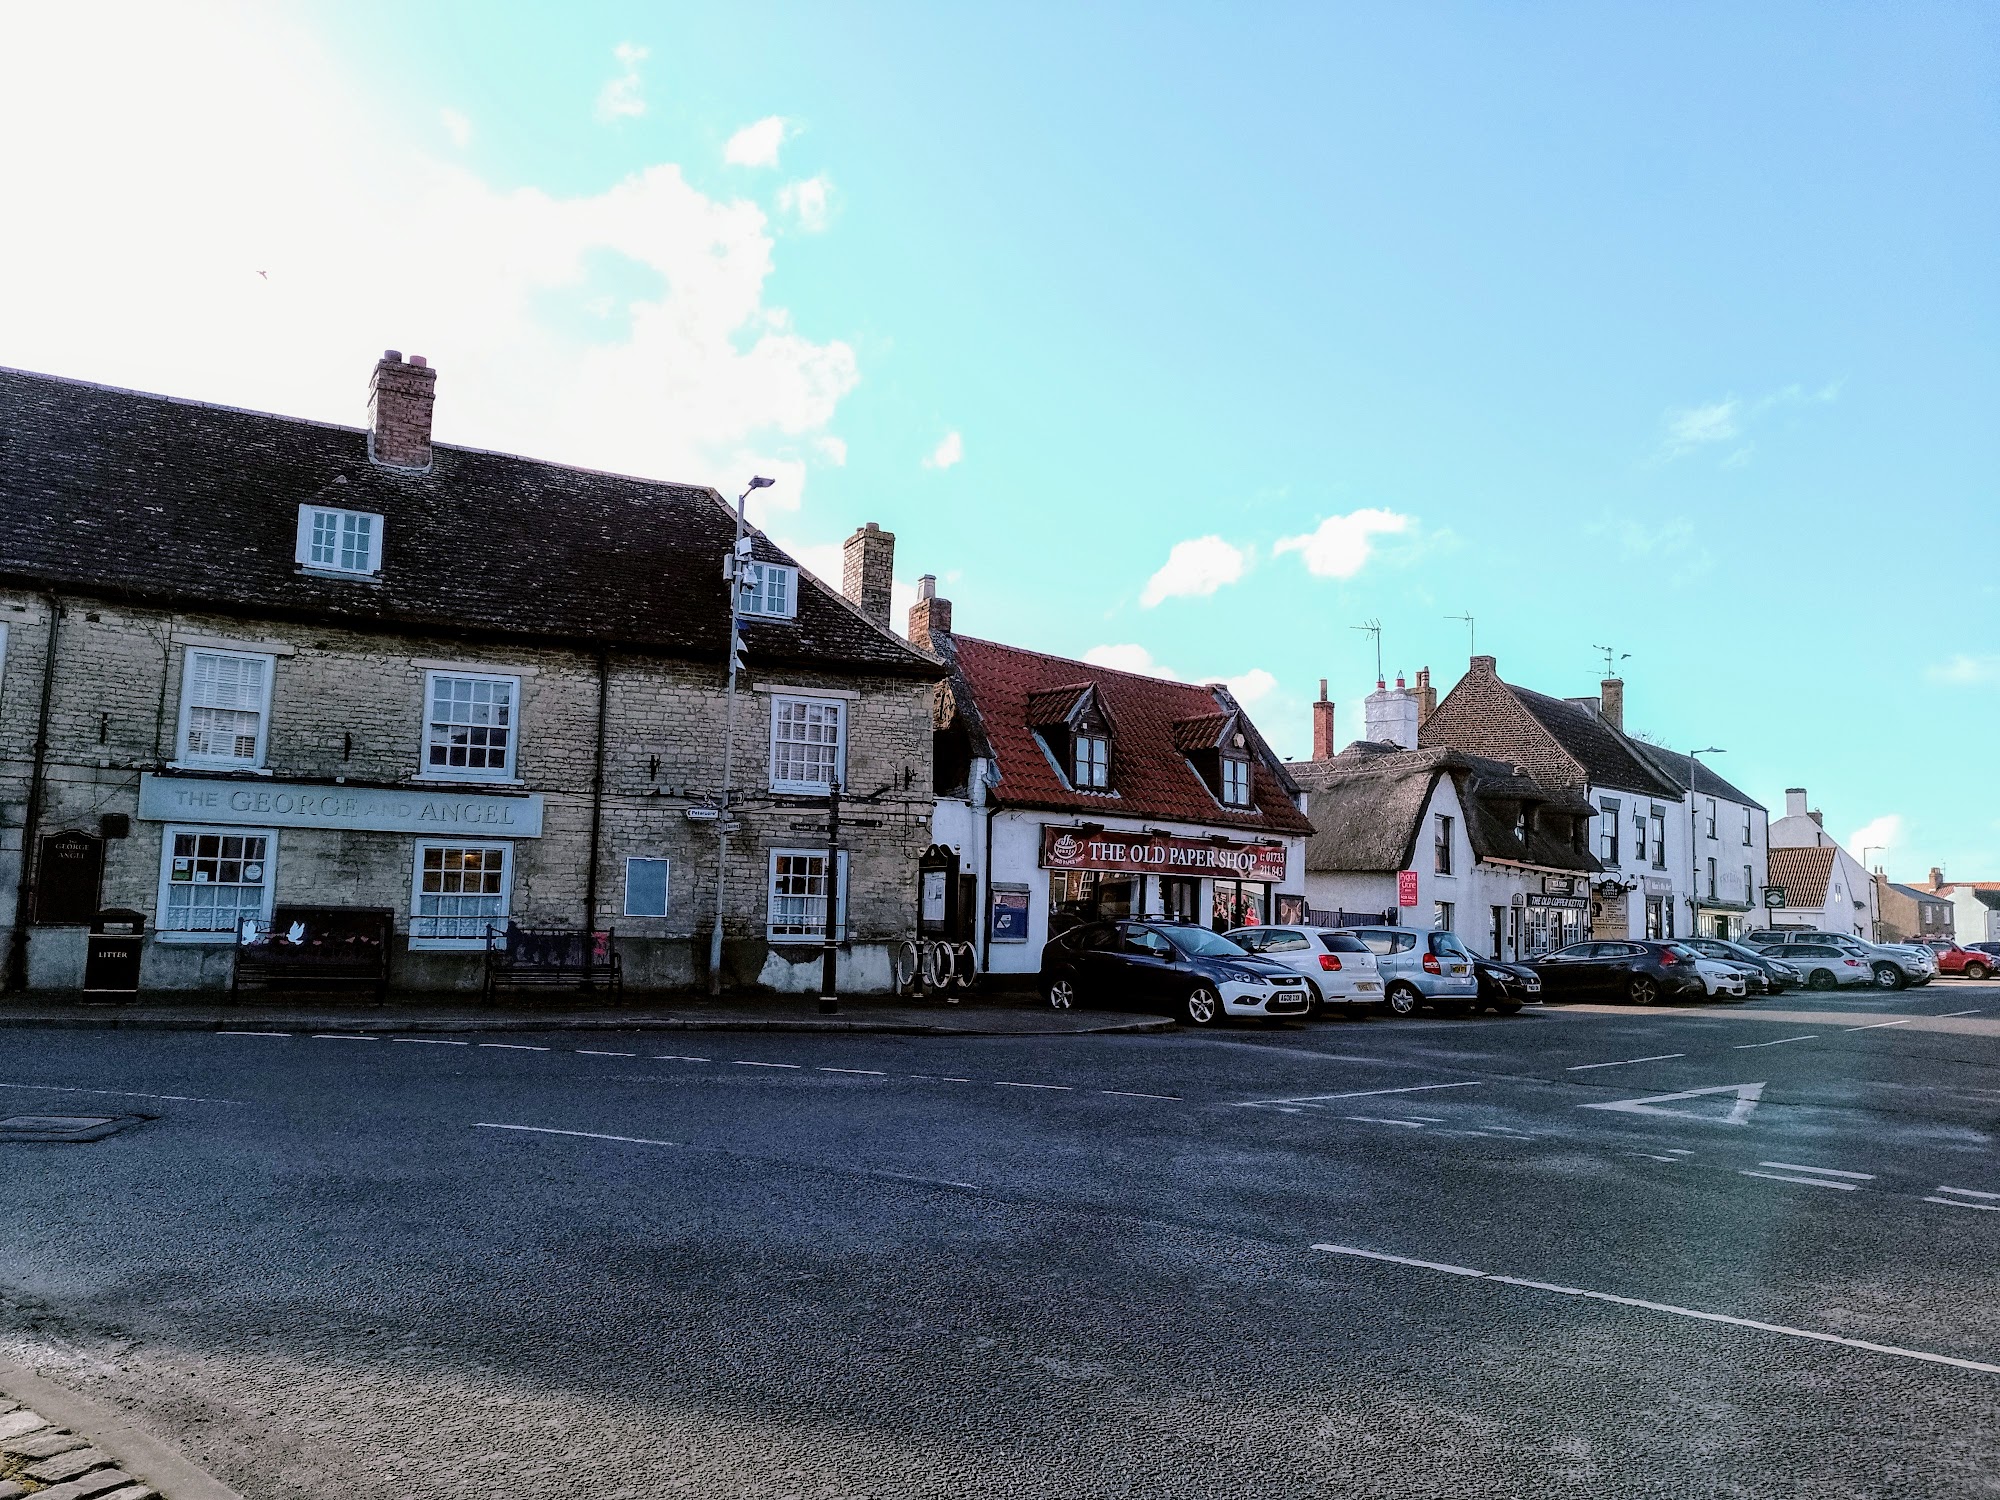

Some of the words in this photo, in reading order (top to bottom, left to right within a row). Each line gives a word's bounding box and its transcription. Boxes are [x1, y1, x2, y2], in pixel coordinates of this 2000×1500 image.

[175, 790, 219, 807] THE
[231, 791, 358, 818] GEORGE
[364, 803, 412, 818] AND
[417, 802, 515, 825] ANGEL
[1088, 842, 1127, 862] THE
[1130, 844, 1166, 864] OLD
[1168, 847, 1216, 868] PAPER
[1218, 851, 1258, 871] SHOP
[1265, 852, 1285, 863] 01733
[1259, 866, 1271, 876] 211
[1272, 867, 1284, 877] 843
[1532, 896, 1541, 905] THE
[1541, 897, 1551, 906] OLD
[98, 951, 128, 959] LITTER
